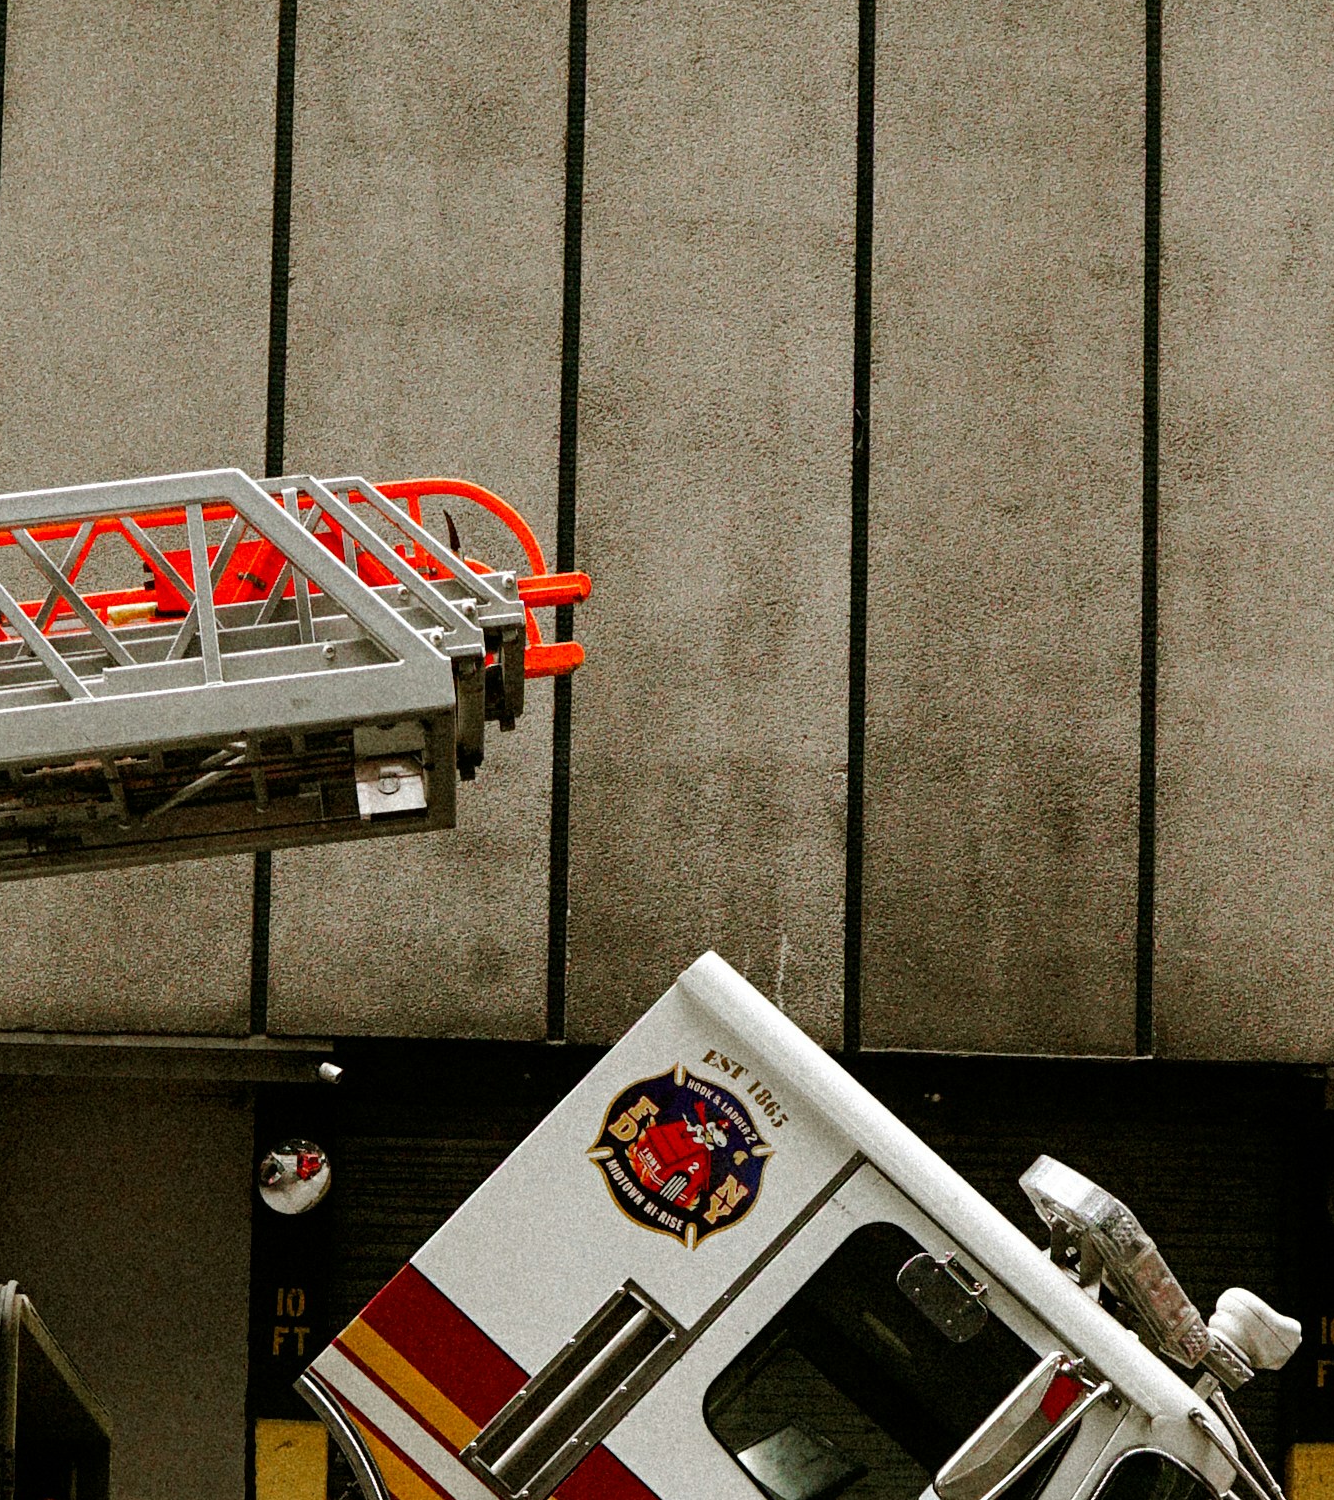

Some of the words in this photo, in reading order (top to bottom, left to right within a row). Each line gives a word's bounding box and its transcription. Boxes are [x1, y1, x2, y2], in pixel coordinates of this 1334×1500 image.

[686, 1078, 715, 1100] HOOK
[712, 1095, 722, 1106] &
[720, 1102, 751, 1135] LADDER
[744, 1133, 758, 1145] 2
[702, 1049, 749, 1080] EST
[747, 1080, 789, 1128] 1865
[606, 1158, 646, 1206] MIDTOWN
[687, 1161, 700, 1175] 2
[272, 1325, 311, 1357] FT
